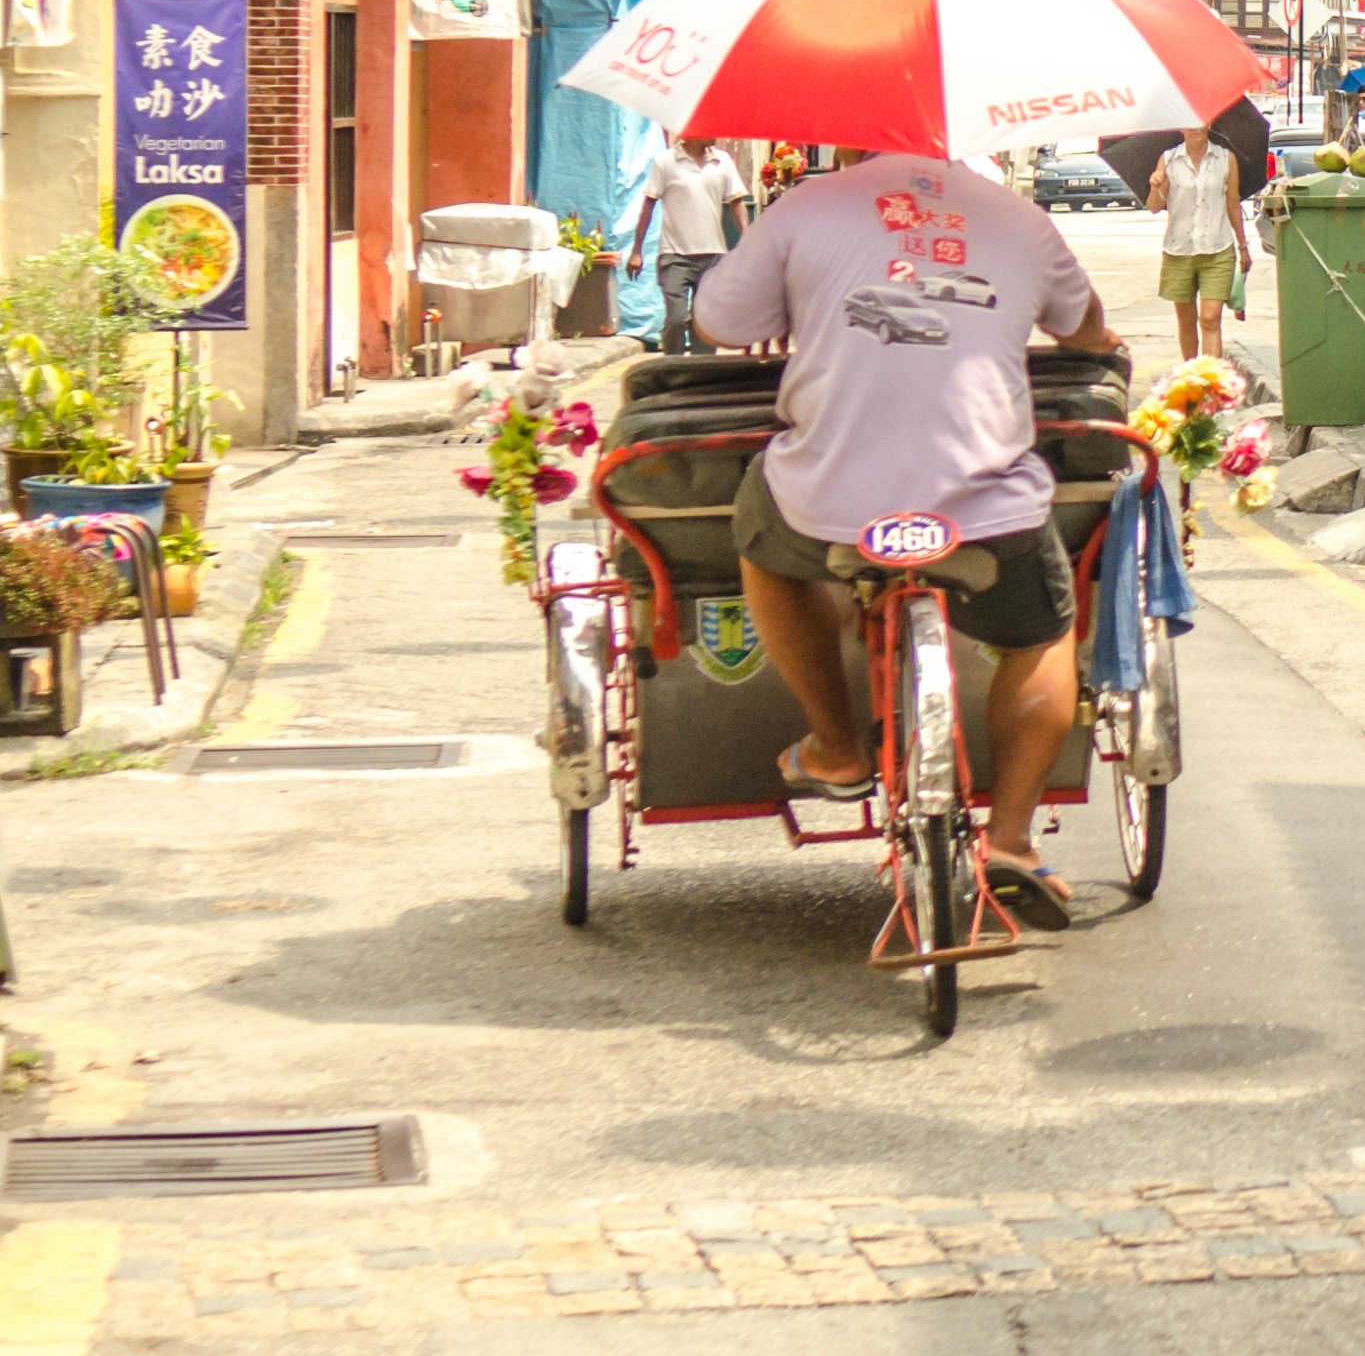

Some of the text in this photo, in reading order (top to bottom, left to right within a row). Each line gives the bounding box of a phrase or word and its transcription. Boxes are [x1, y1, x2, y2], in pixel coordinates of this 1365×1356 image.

[136, 23, 227, 71] 素食
[134, 78, 226, 122] 叻沙
[987, 87, 1136, 126] NISSAN
[134, 133, 226, 156] Vegetarian
[135, 154, 225, 185] Laksa
[889, 260, 914, 282] 2
[872, 525, 945, 553] 1460
